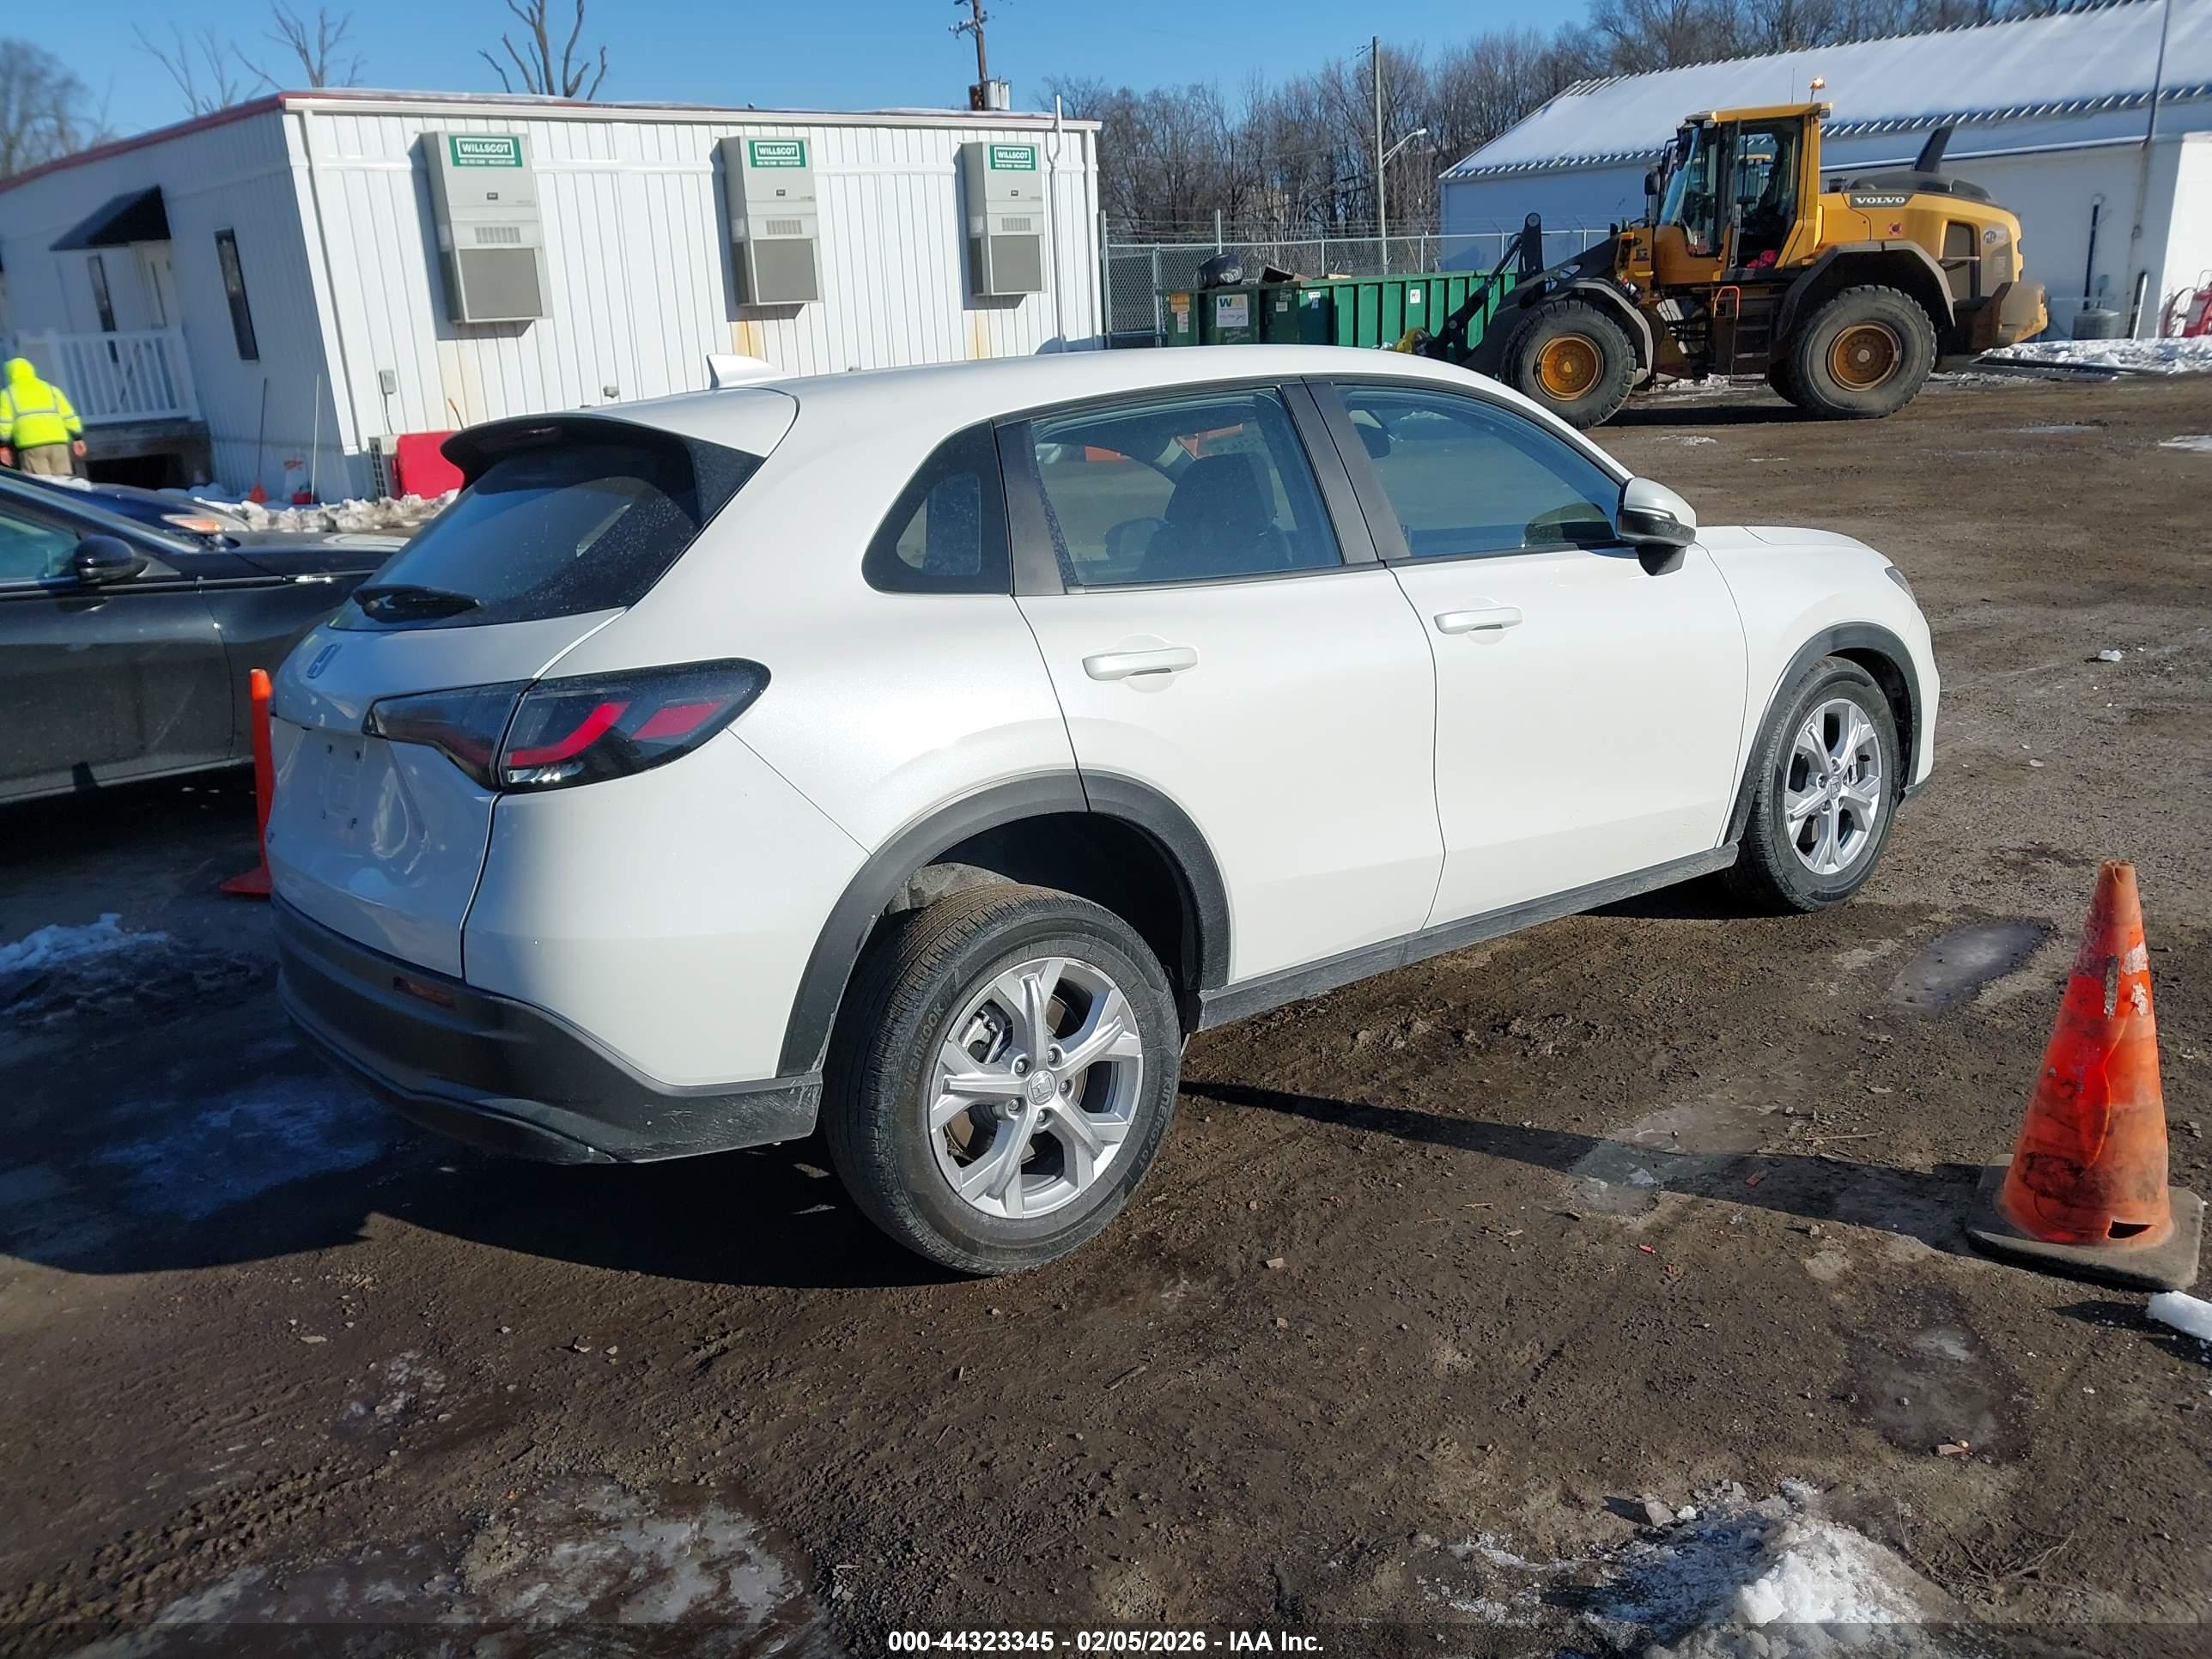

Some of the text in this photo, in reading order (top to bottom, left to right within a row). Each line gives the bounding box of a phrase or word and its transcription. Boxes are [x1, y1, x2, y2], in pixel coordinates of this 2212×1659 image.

[461, 143, 508, 153] WILLSCOT
[758, 147, 795, 155] WILLSCOT
[997, 150, 1028, 160] WILLSCOT
